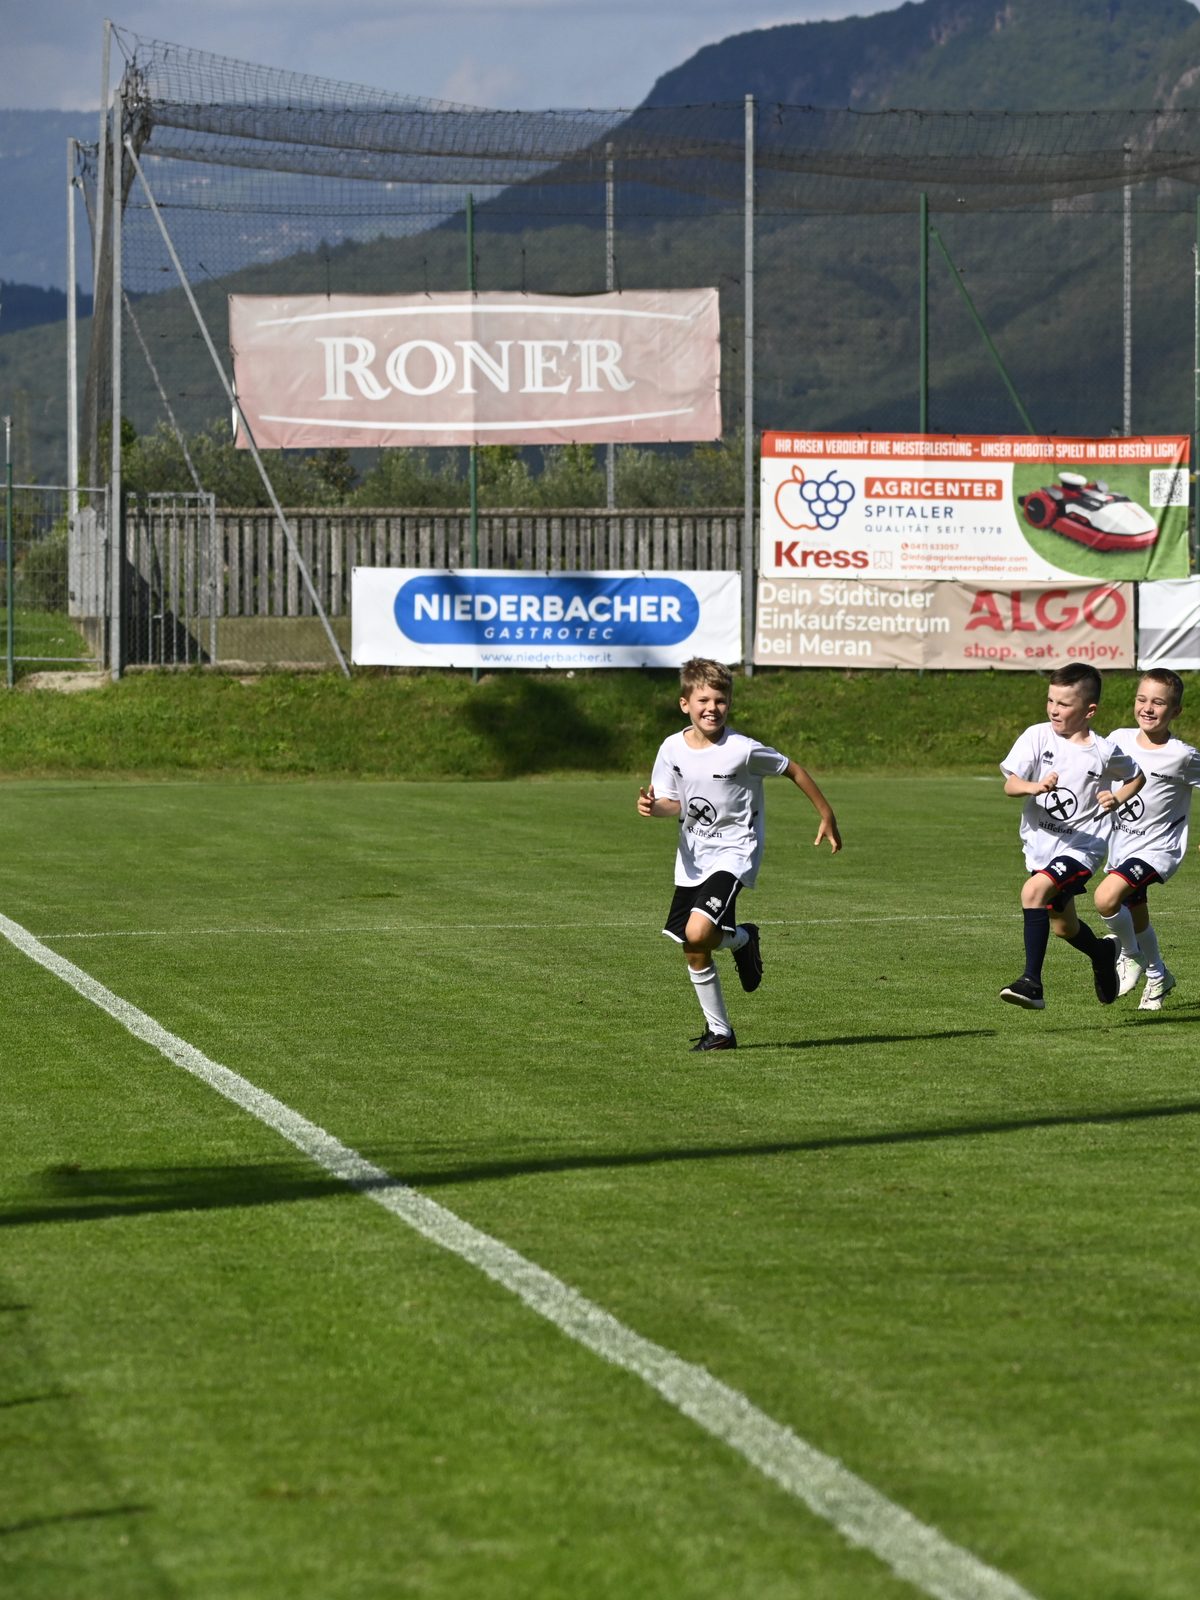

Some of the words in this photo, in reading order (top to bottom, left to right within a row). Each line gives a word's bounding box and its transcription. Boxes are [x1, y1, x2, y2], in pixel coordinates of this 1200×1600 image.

[315, 336, 635, 400] RONER
[775, 439, 792, 453] IHR
[793, 439, 823, 454] RASEN
[826, 440, 869, 455] VERDIENT
[870, 441, 891, 455] EINE
[892, 441, 972, 457] MEISTERLEISTUNG
[981, 443, 1012, 457] UNSER
[1013, 443, 1055, 458] ROBOTER
[1056, 443, 1085, 458] SPIELT
[1086, 443, 1097, 458] IN
[1098, 443, 1117, 458] DER
[1118, 443, 1152, 458] ERSTEN
[1154, 443, 1177, 458] LIGA!
[870, 480, 997, 497] AGRICENTER
[864, 505, 954, 519] SPITALER
[864, 524, 929, 534] QUALITÄT
[937, 525, 965, 534] SEIT
[973, 526, 1003, 535] 1978
[774, 541, 869, 569] Kress
[758, 583, 811, 605] Dein
[819, 583, 935, 609] Südtiroler
[414, 594, 682, 622] NIEDERBACHER
[964, 587, 1126, 631] ALGO
[758, 608, 950, 633] Einkaufszentrum
[484, 627, 614, 640] GASTROTEC
[758, 633, 791, 654] bei
[800, 634, 872, 656] Meran
[964, 643, 1016, 661] shop.
[1025, 645, 1060, 658] eat.
[1067, 643, 1124, 662] enjoy.
[481, 652, 612, 663] www.niederbacher.it
[1038, 820, 1073, 834] aiffeisen
